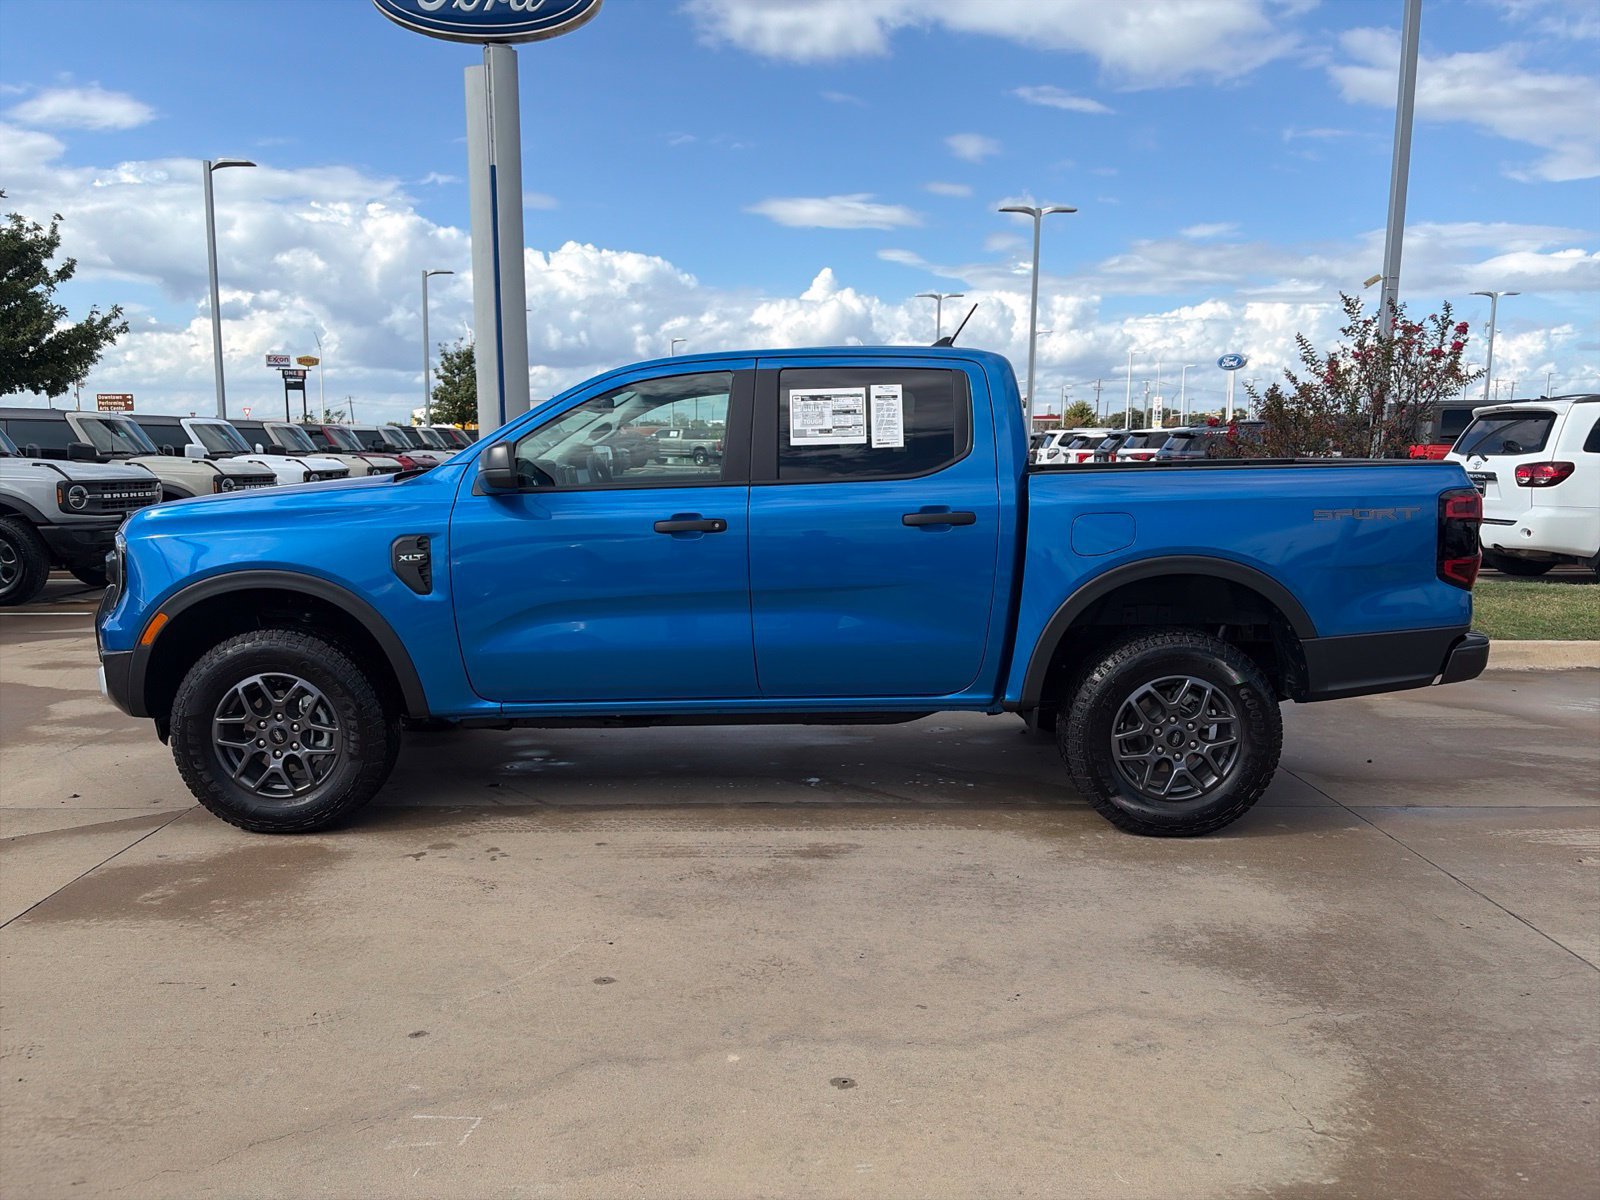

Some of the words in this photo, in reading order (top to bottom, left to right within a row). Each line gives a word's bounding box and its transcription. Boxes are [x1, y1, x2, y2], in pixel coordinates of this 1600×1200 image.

[267, 355, 289, 363] Exxon
[103, 491, 152, 499] BRONCO
[1312, 507, 1421, 521] SPORT
[398, 553, 425, 562] XLT
